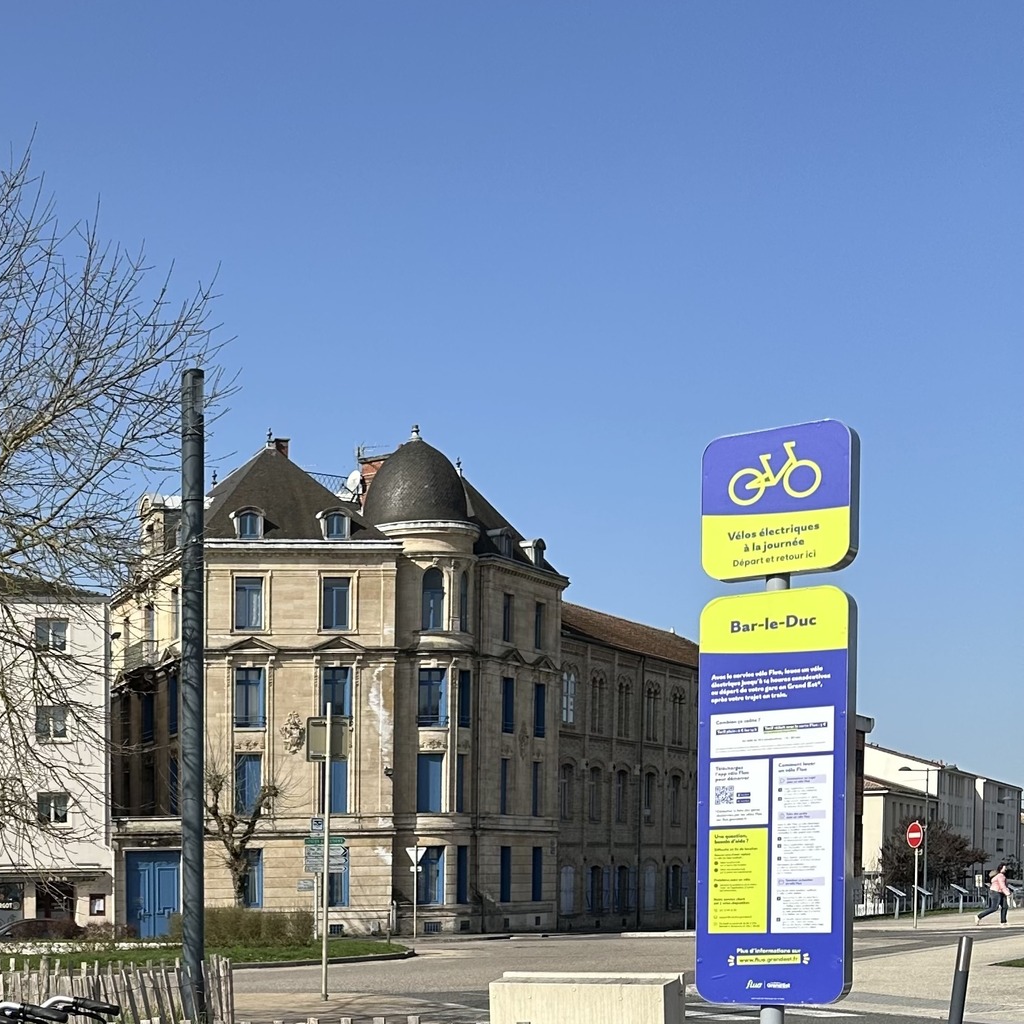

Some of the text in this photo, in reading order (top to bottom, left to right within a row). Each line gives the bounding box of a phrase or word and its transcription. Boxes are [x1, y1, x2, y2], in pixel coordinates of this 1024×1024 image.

[728, 522, 820, 541] Vélos électriques
[743, 538, 805, 553] à la journée
[732, 556, 764, 568] Départ
[776, 553, 803, 562] retour
[805, 549, 816, 558] ici
[730, 615, 817, 633] Bar-le-Duc
[792, 673, 831, 681] consécutives
[745, 979, 763, 990] fluo
